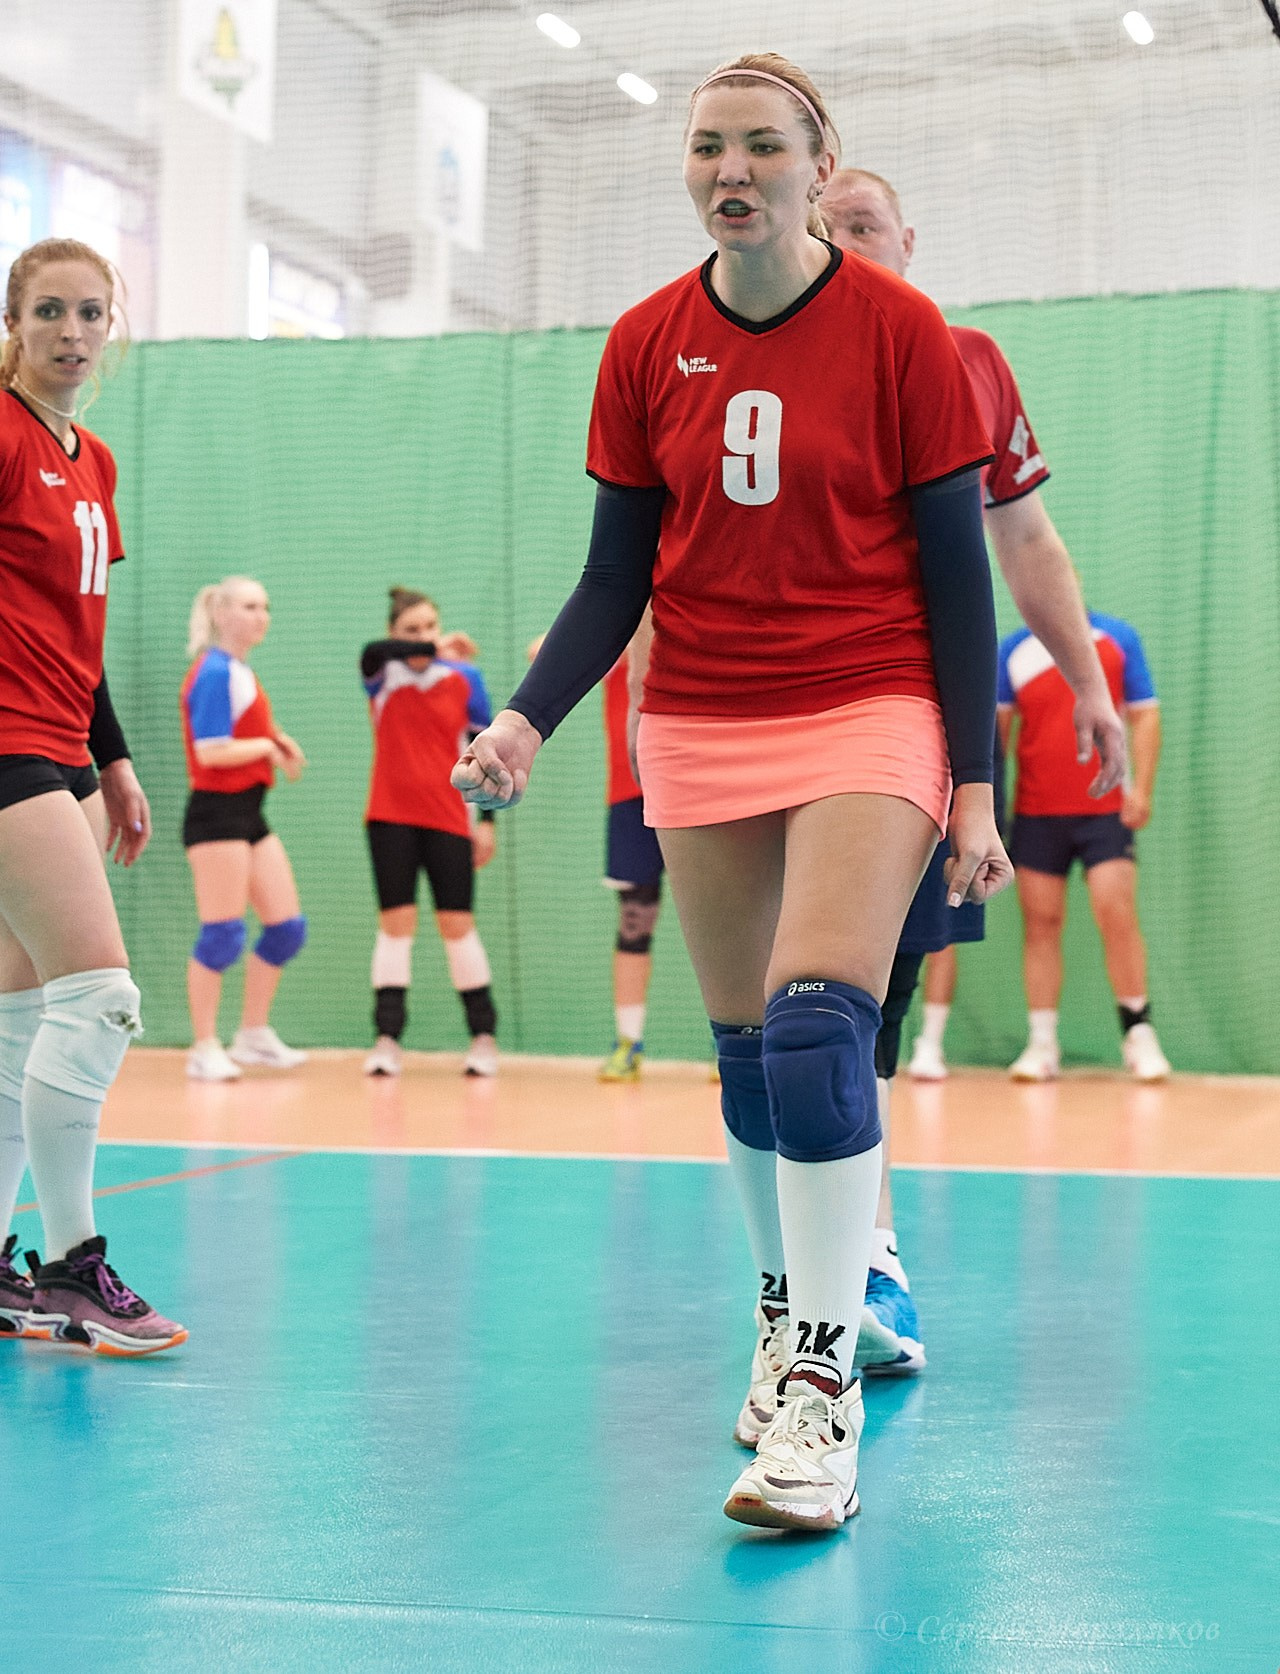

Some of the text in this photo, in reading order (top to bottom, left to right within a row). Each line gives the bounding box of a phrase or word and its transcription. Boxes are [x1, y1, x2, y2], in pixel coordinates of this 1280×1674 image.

[689, 357, 708, 365] NEW
[689, 363, 718, 373] LEAGUE
[722, 389, 783, 506] 9
[72, 500, 108, 596] 11
[797, 982, 826, 993] asics
